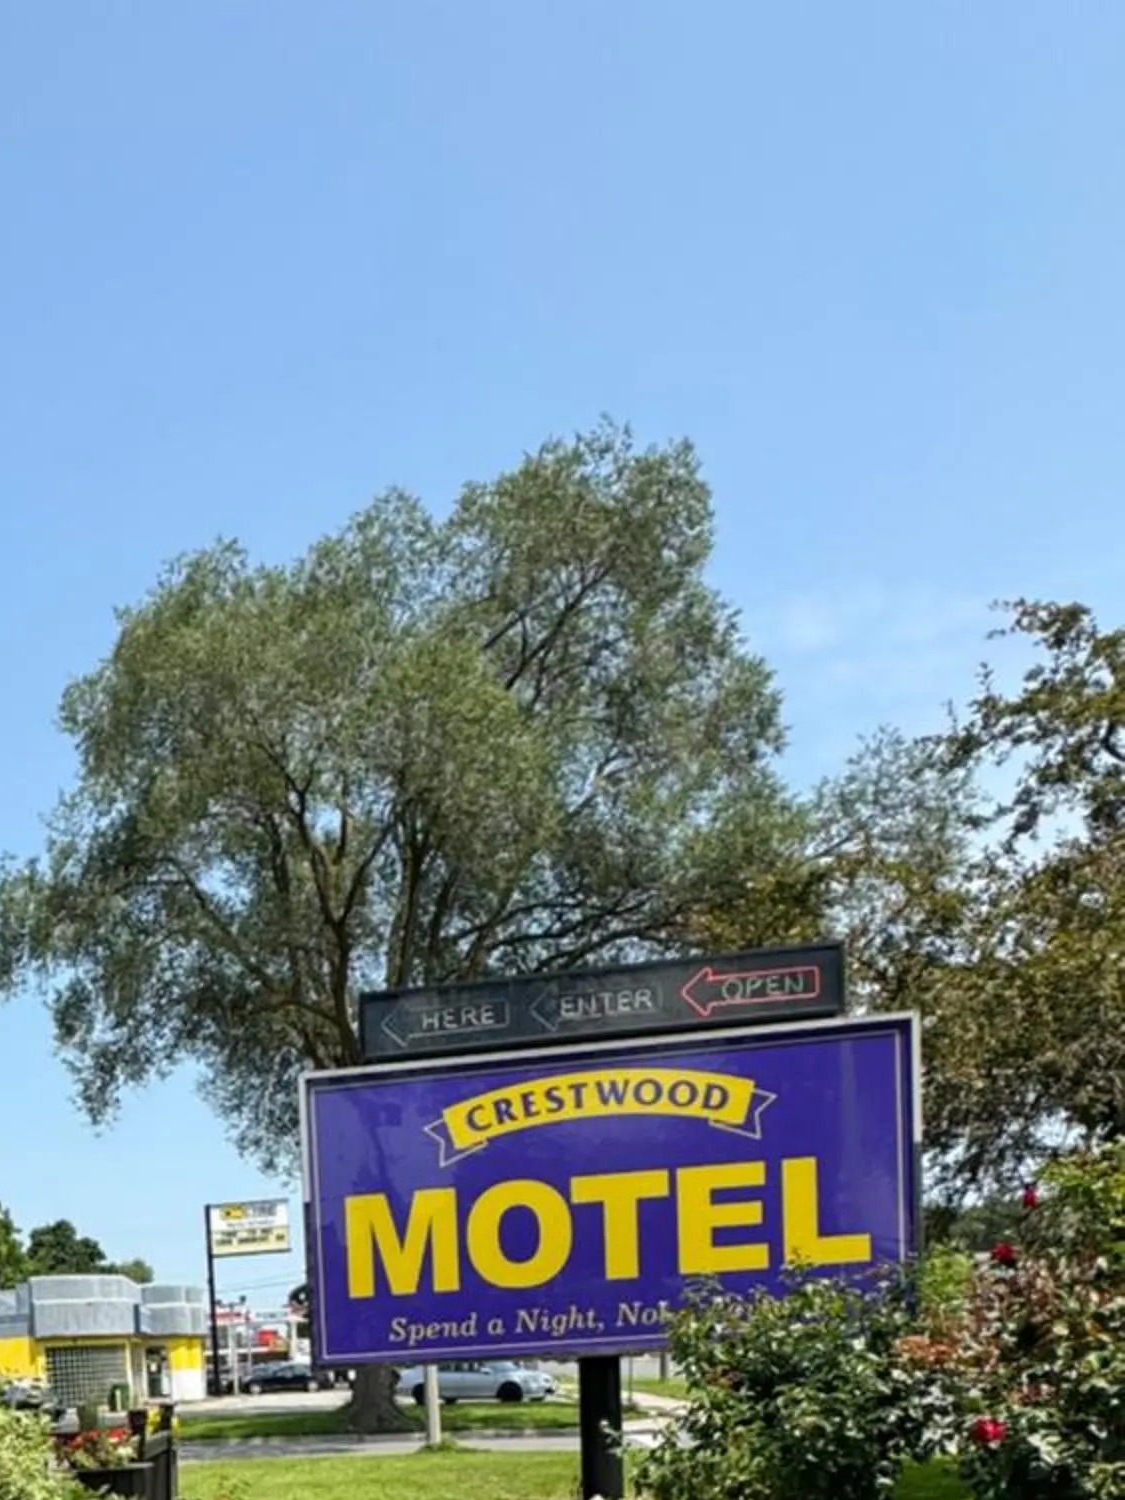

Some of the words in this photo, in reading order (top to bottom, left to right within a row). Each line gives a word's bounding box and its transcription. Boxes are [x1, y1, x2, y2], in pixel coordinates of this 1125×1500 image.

[420, 1003, 496, 1030] HERE
[559, 988, 654, 1018] ENTER
[720, 971, 805, 1001] OPEN
[465, 1078, 730, 1132] CRESTWOOD
[344, 1156, 871, 1298] MOTEL
[389, 1312, 478, 1345] Spend
[487, 1316, 505, 1335] a
[513, 1305, 606, 1338] Night,
